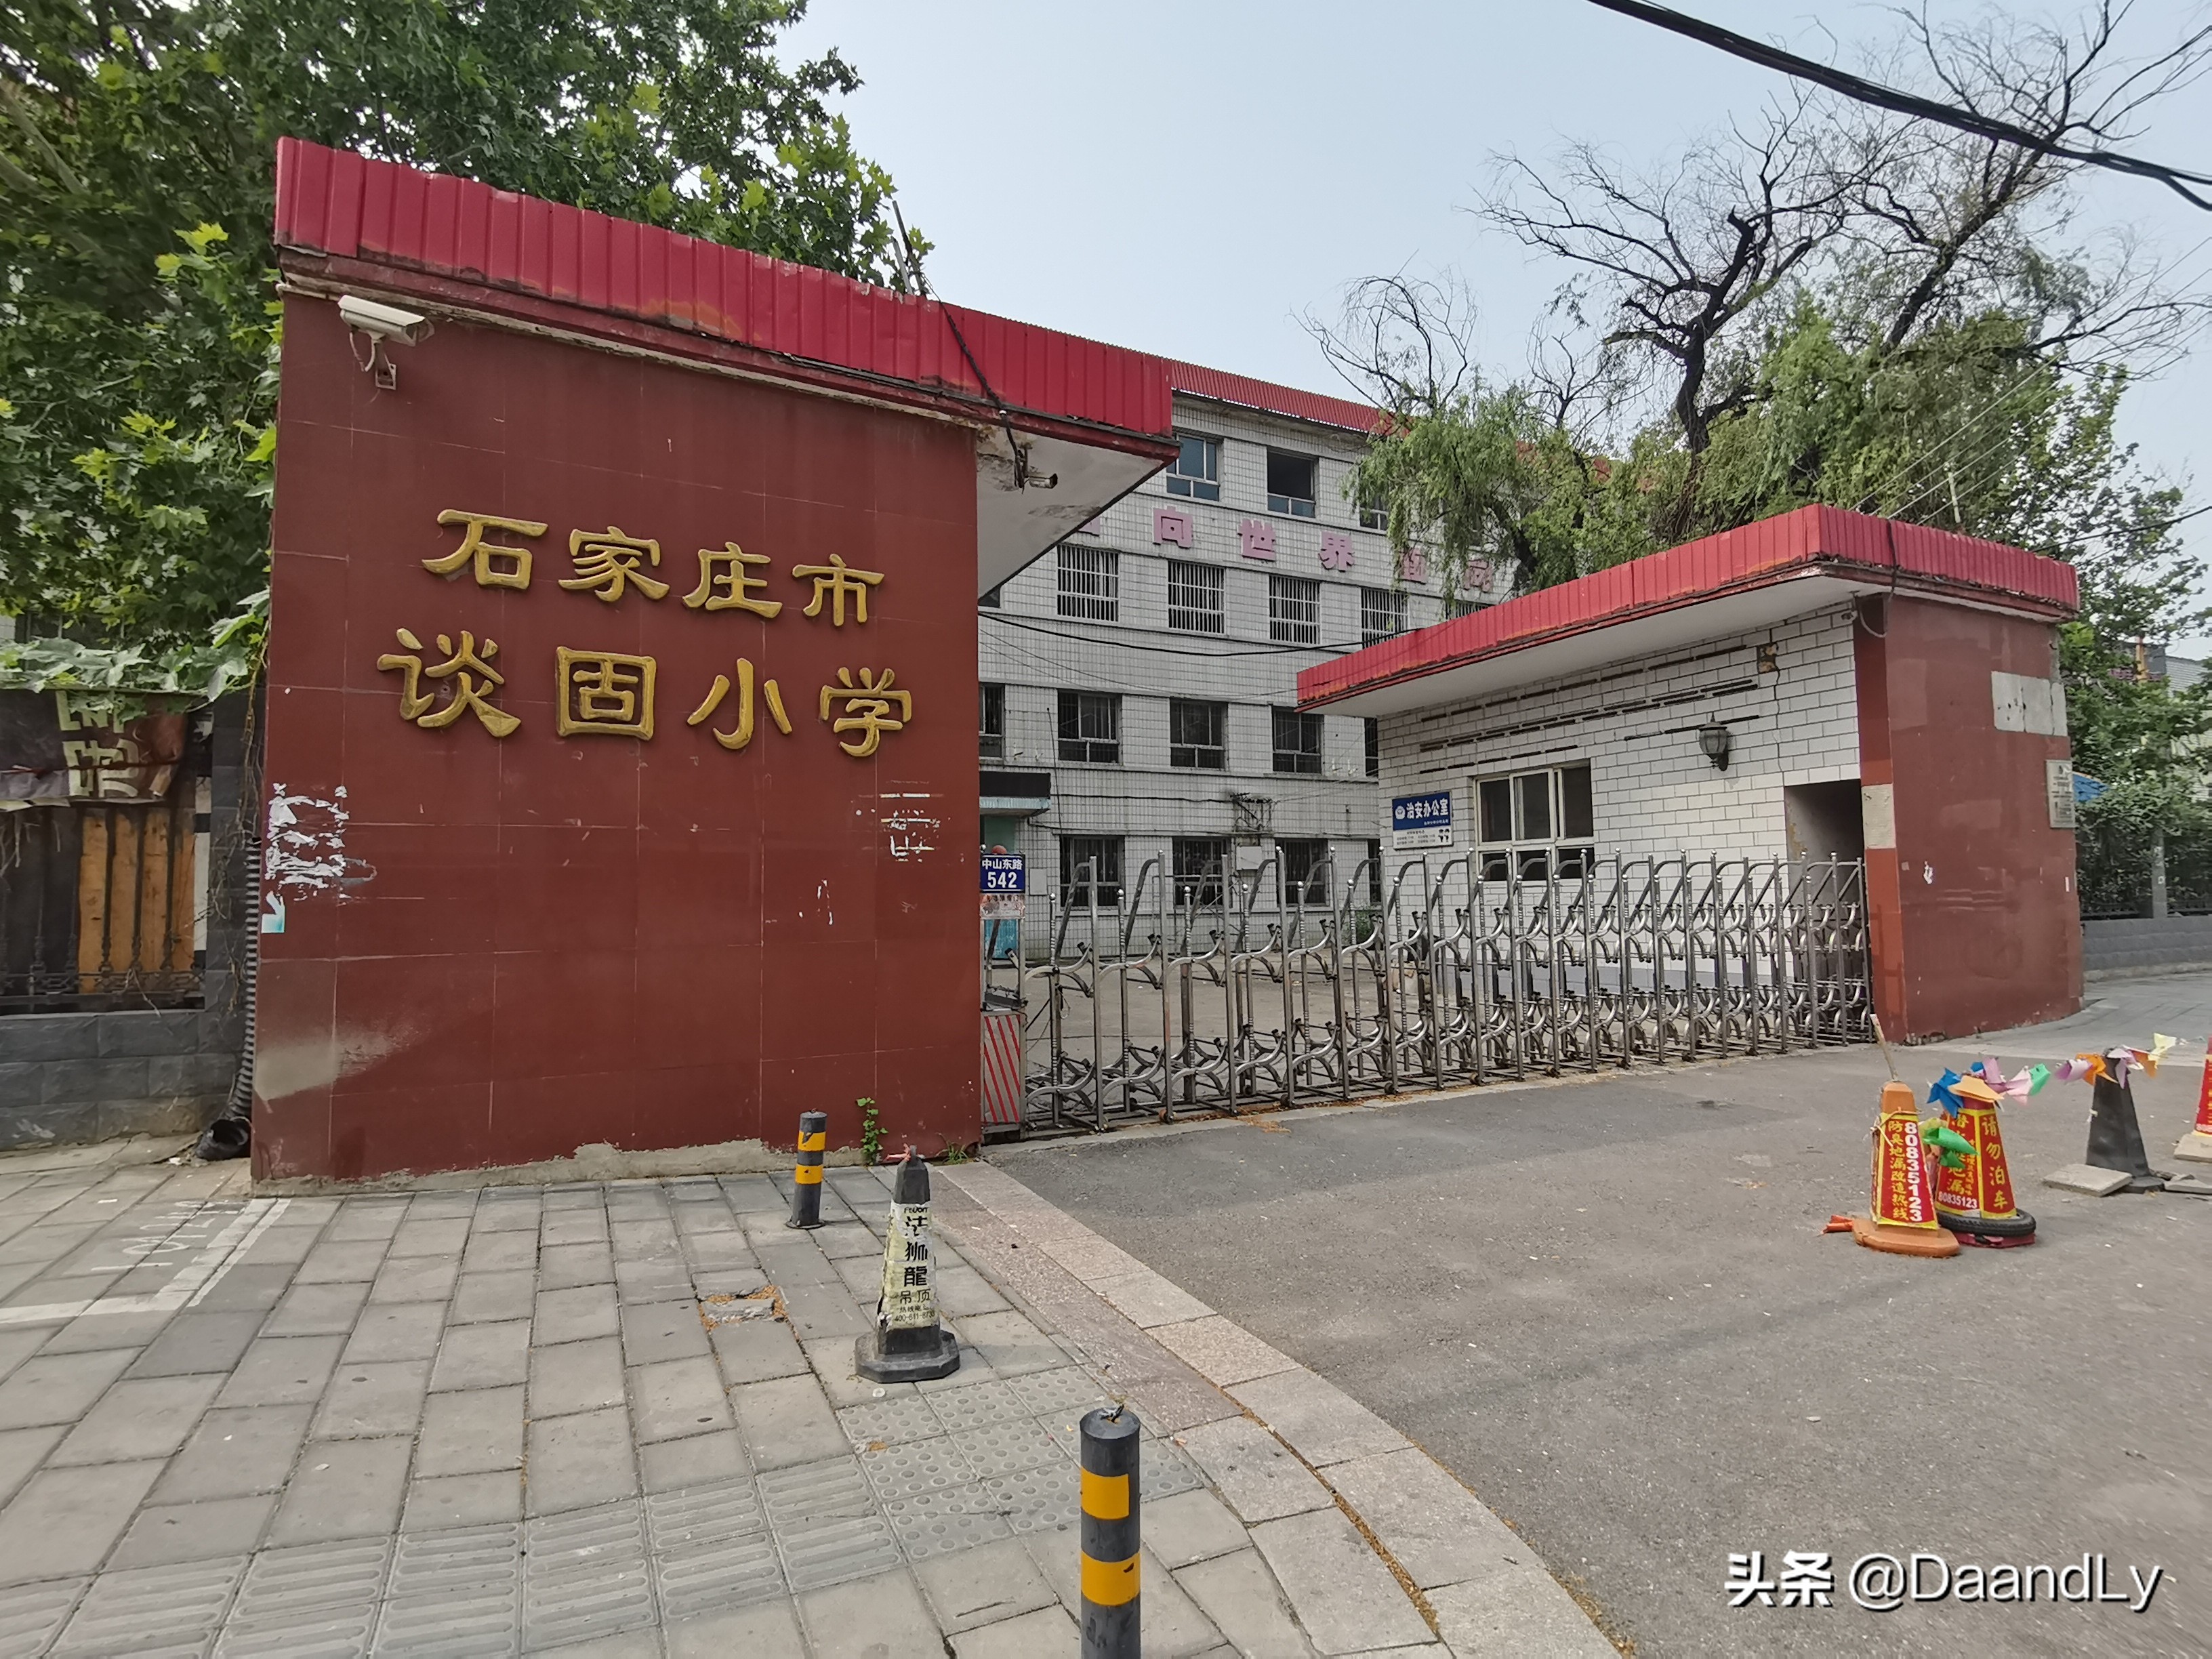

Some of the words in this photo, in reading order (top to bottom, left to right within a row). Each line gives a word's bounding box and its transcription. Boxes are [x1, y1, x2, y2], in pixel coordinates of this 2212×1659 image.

[422, 508, 884, 626] 石家庄市
[377, 628, 912, 757] 谈固小学
[1406, 798, 1449, 819] 治安办公室
[981, 858, 1023, 870] 中山东路
[987, 872, 1017, 888] 542
[1887, 1120, 1910, 1221] 防臭地漏改造热线
[1904, 1122, 1923, 1222] 80835123
[1982, 1115, 2009, 1210] 请勿泊车
[1938, 1191, 1978, 1209] 80835123
[899, 1288, 931, 1305] 吊顶
